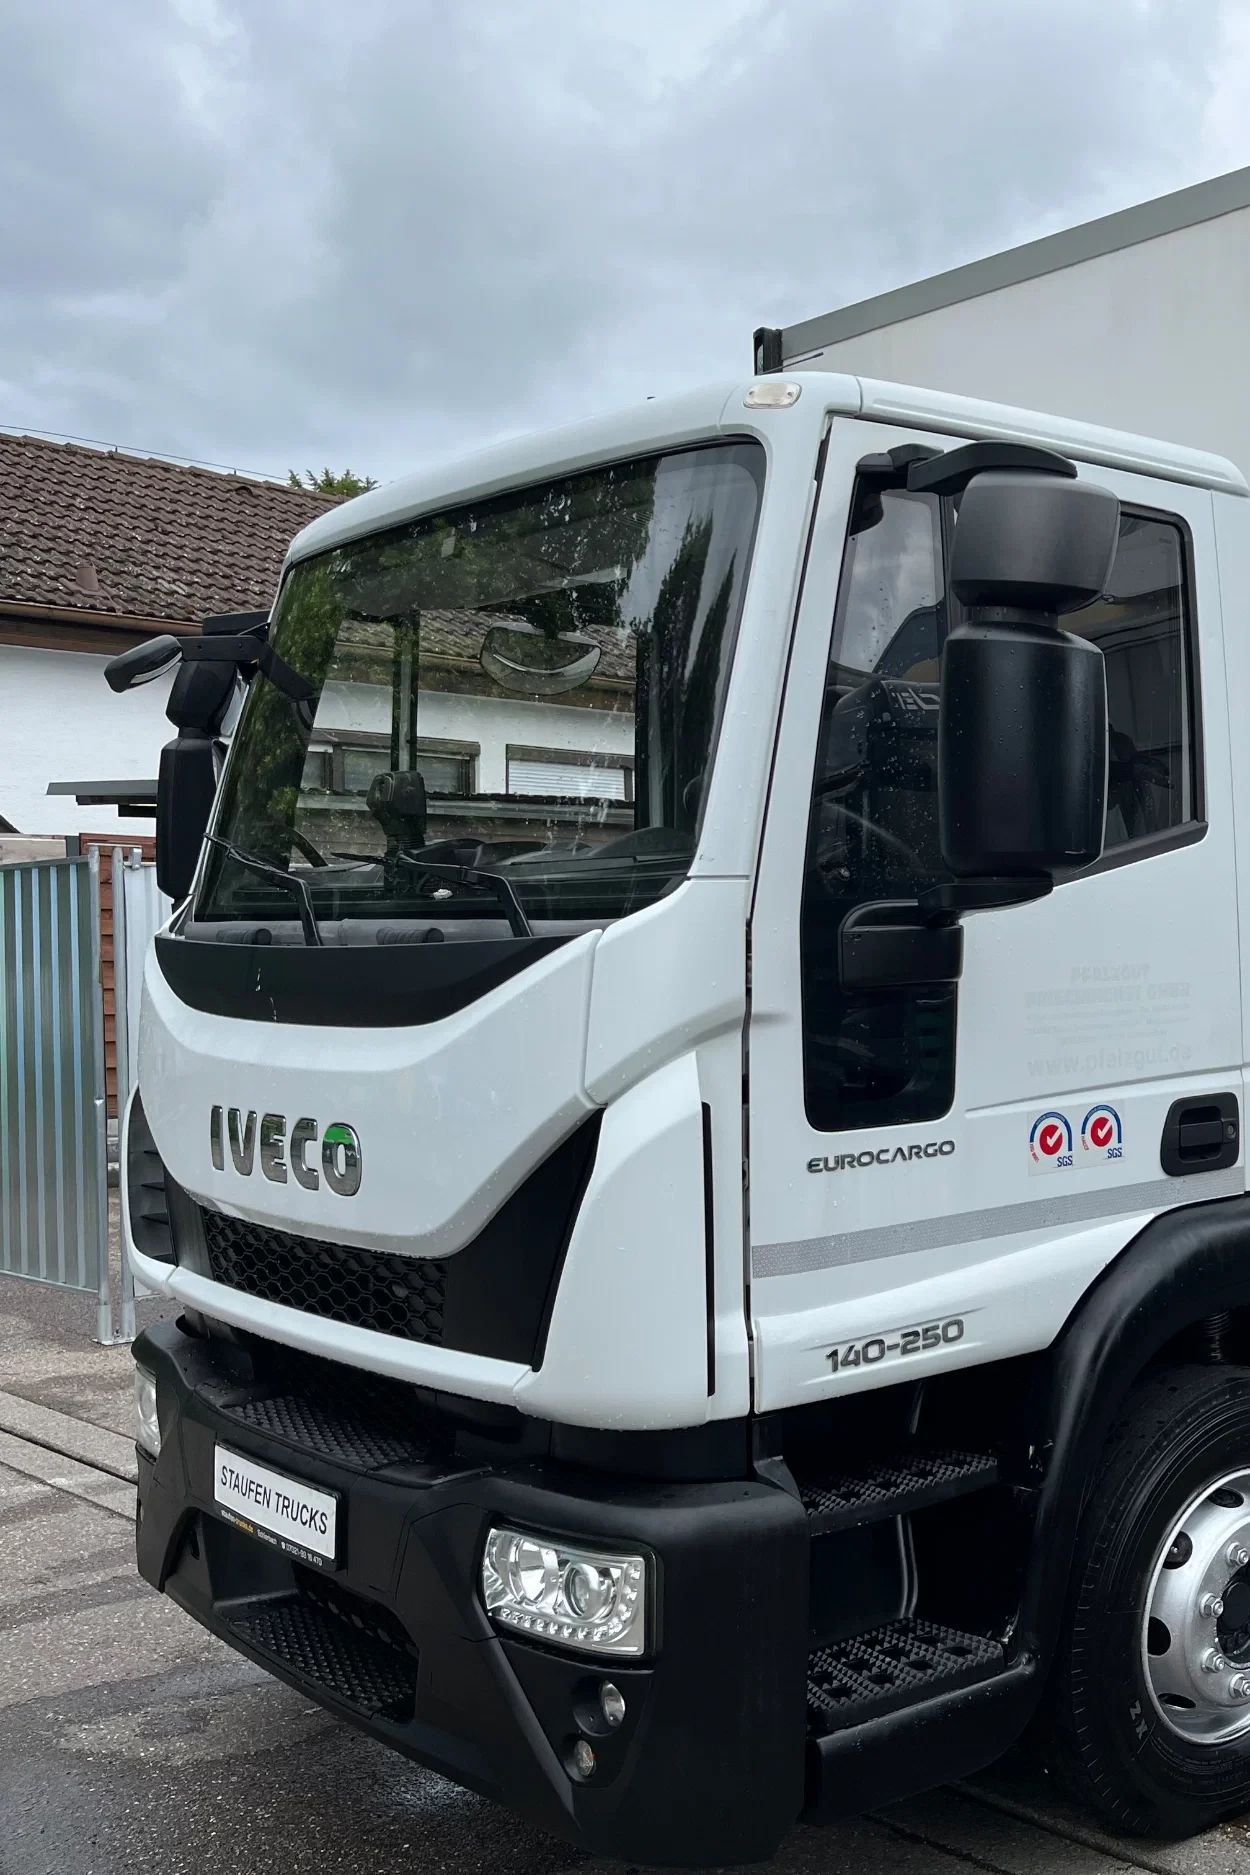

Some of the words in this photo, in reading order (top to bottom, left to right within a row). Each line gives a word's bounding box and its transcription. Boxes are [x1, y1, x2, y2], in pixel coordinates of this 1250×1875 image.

[210, 1105, 362, 1197] IVECO
[806, 1140, 956, 1174] EUROCARGO
[1057, 1155, 1073, 1168] SGS
[1107, 1147, 1123, 1159] SGS
[825, 1318, 965, 1373] 140-250
[220, 1465, 272, 1509] STAUFEN
[275, 1491, 328, 1535] TRUCKS
